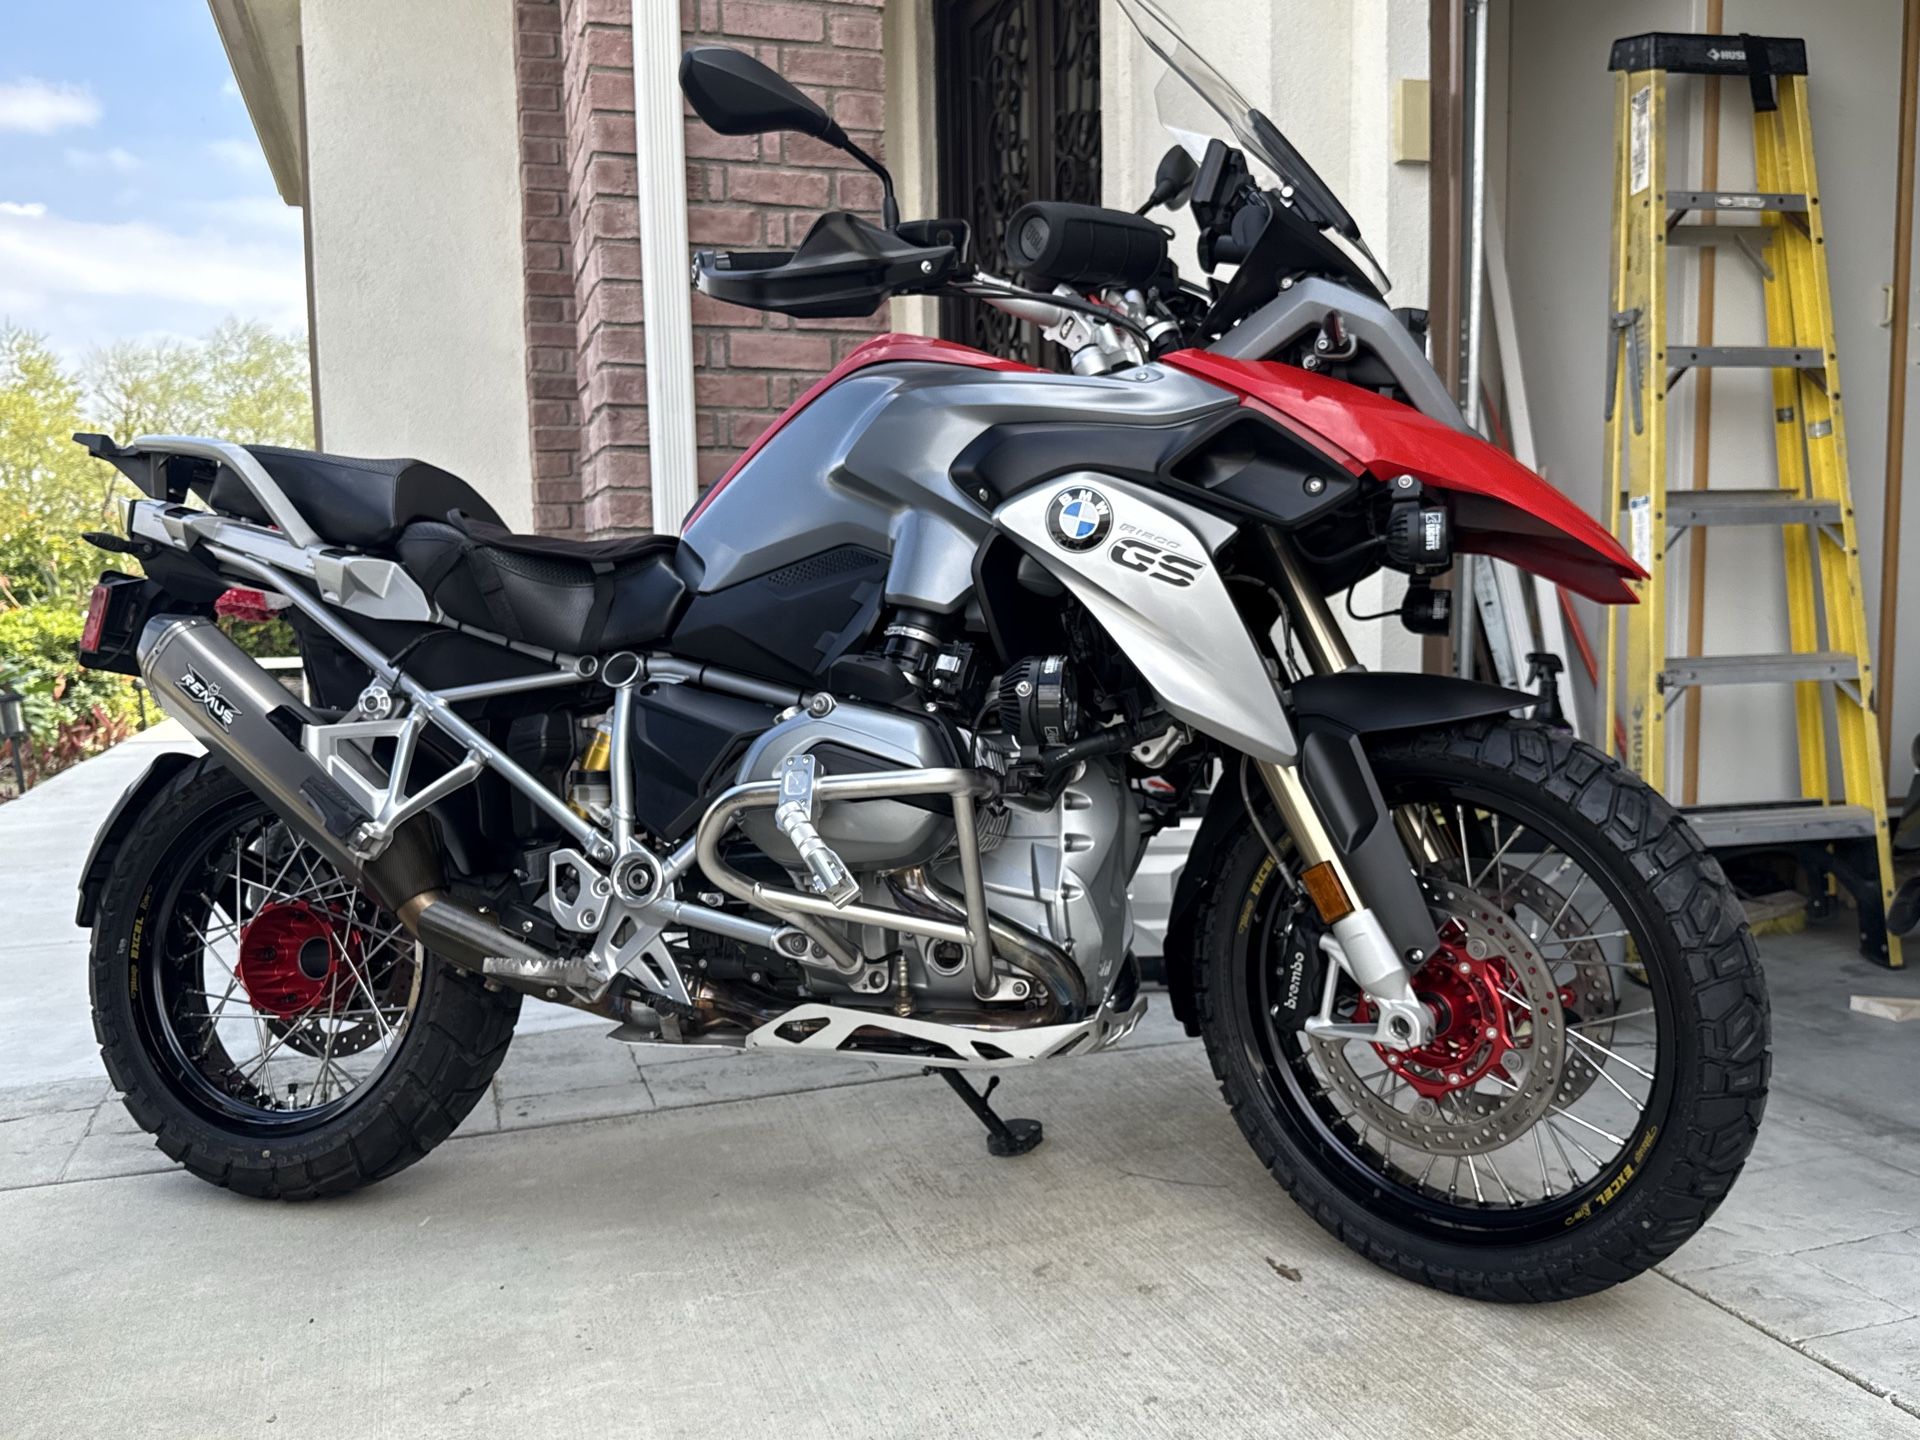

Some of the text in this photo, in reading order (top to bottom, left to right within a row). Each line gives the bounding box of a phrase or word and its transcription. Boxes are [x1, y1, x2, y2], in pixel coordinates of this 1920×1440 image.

[1720, 50, 1747, 60] HUS
[1058, 489, 1109, 515] BMW
[1110, 539, 1204, 588] GS
[181, 673, 234, 724] REMUS
[1633, 725, 1643, 773] HUS
[131, 917, 144, 959] EXCEL
[1284, 952, 1305, 1010] brembo
[1595, 1164, 1635, 1205] EXCEL
